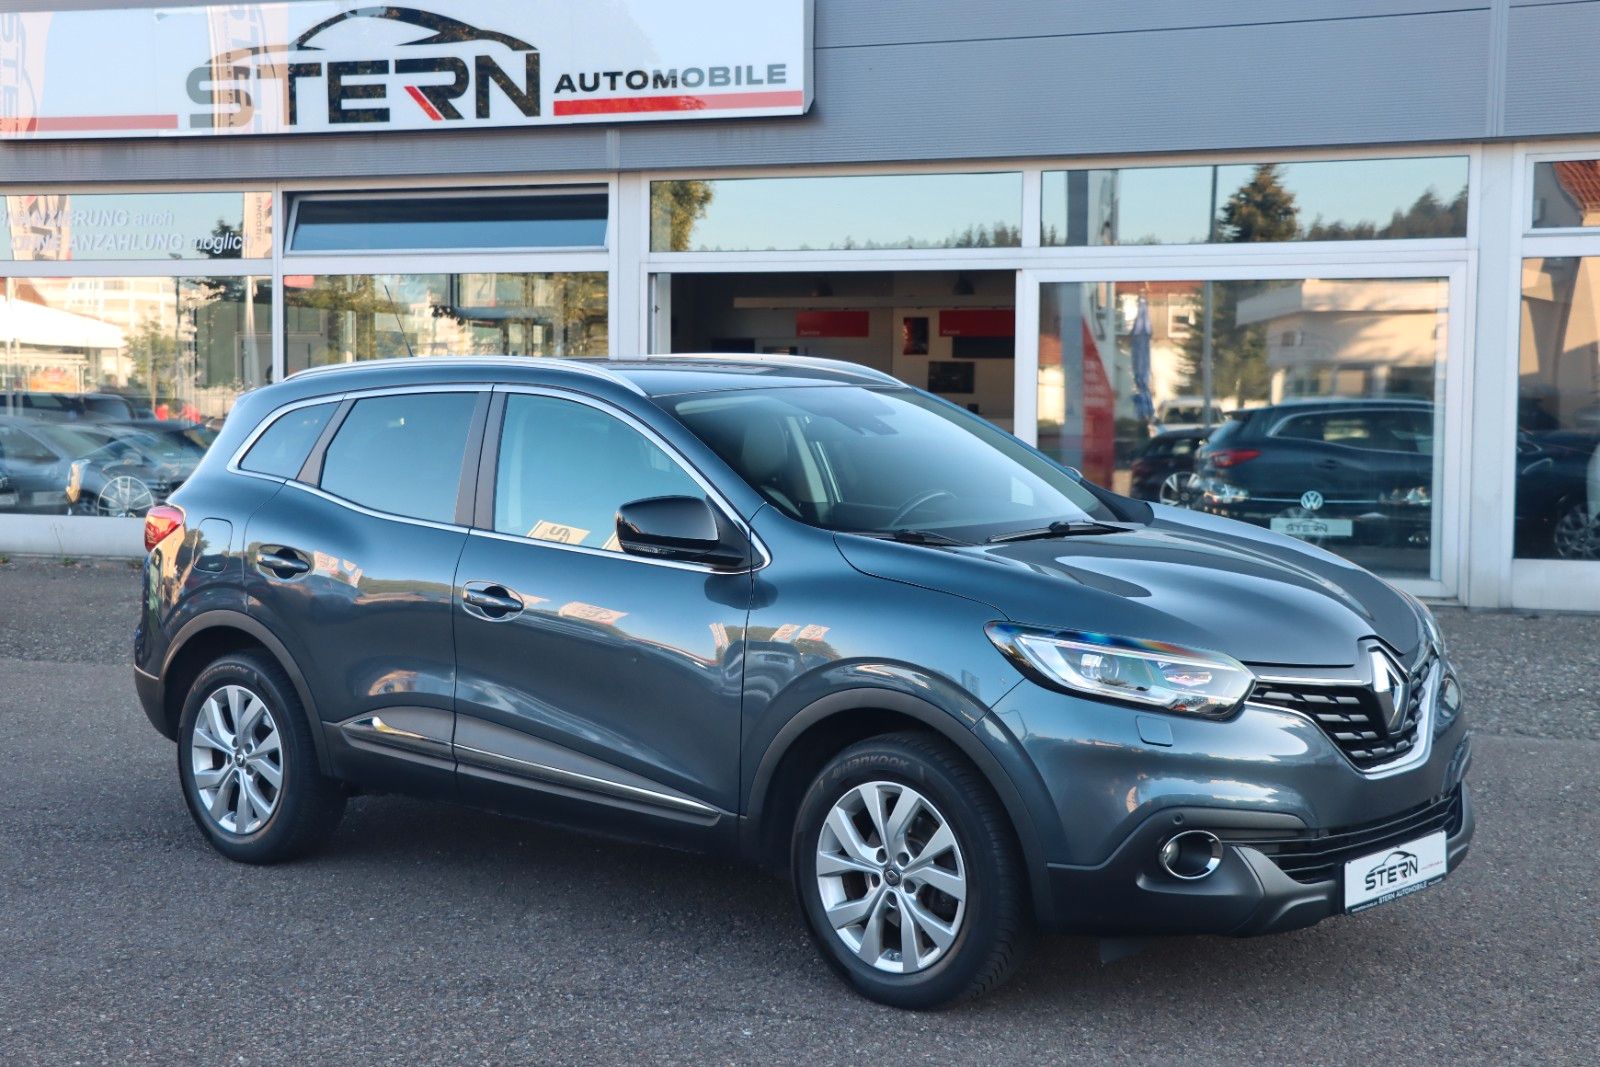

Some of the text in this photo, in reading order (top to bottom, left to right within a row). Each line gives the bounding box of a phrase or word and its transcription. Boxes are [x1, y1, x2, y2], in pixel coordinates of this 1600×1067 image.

[186, 52, 787, 129] STERN AUTOMOBILE
[70, 232, 185, 250] ANZAHLUNG
[1365, 860, 1418, 891] STERN
